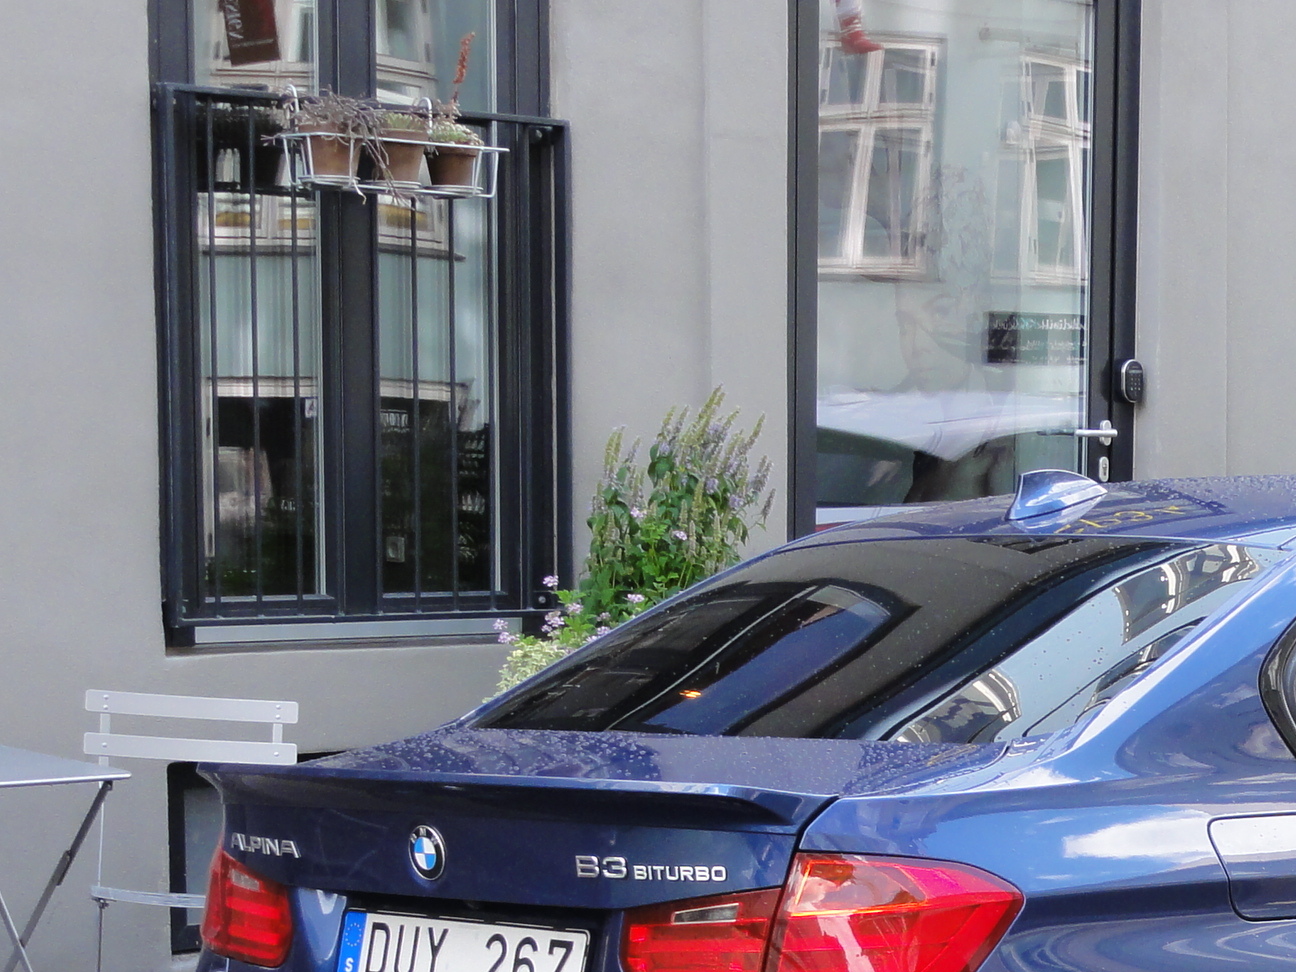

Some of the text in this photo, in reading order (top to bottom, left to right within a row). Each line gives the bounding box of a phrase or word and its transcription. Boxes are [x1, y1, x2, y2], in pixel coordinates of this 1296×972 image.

[230, 832, 302, 858] ALPINA
[575, 855, 727, 882] B3 BITURBO
[344, 957, 355, 972] S
